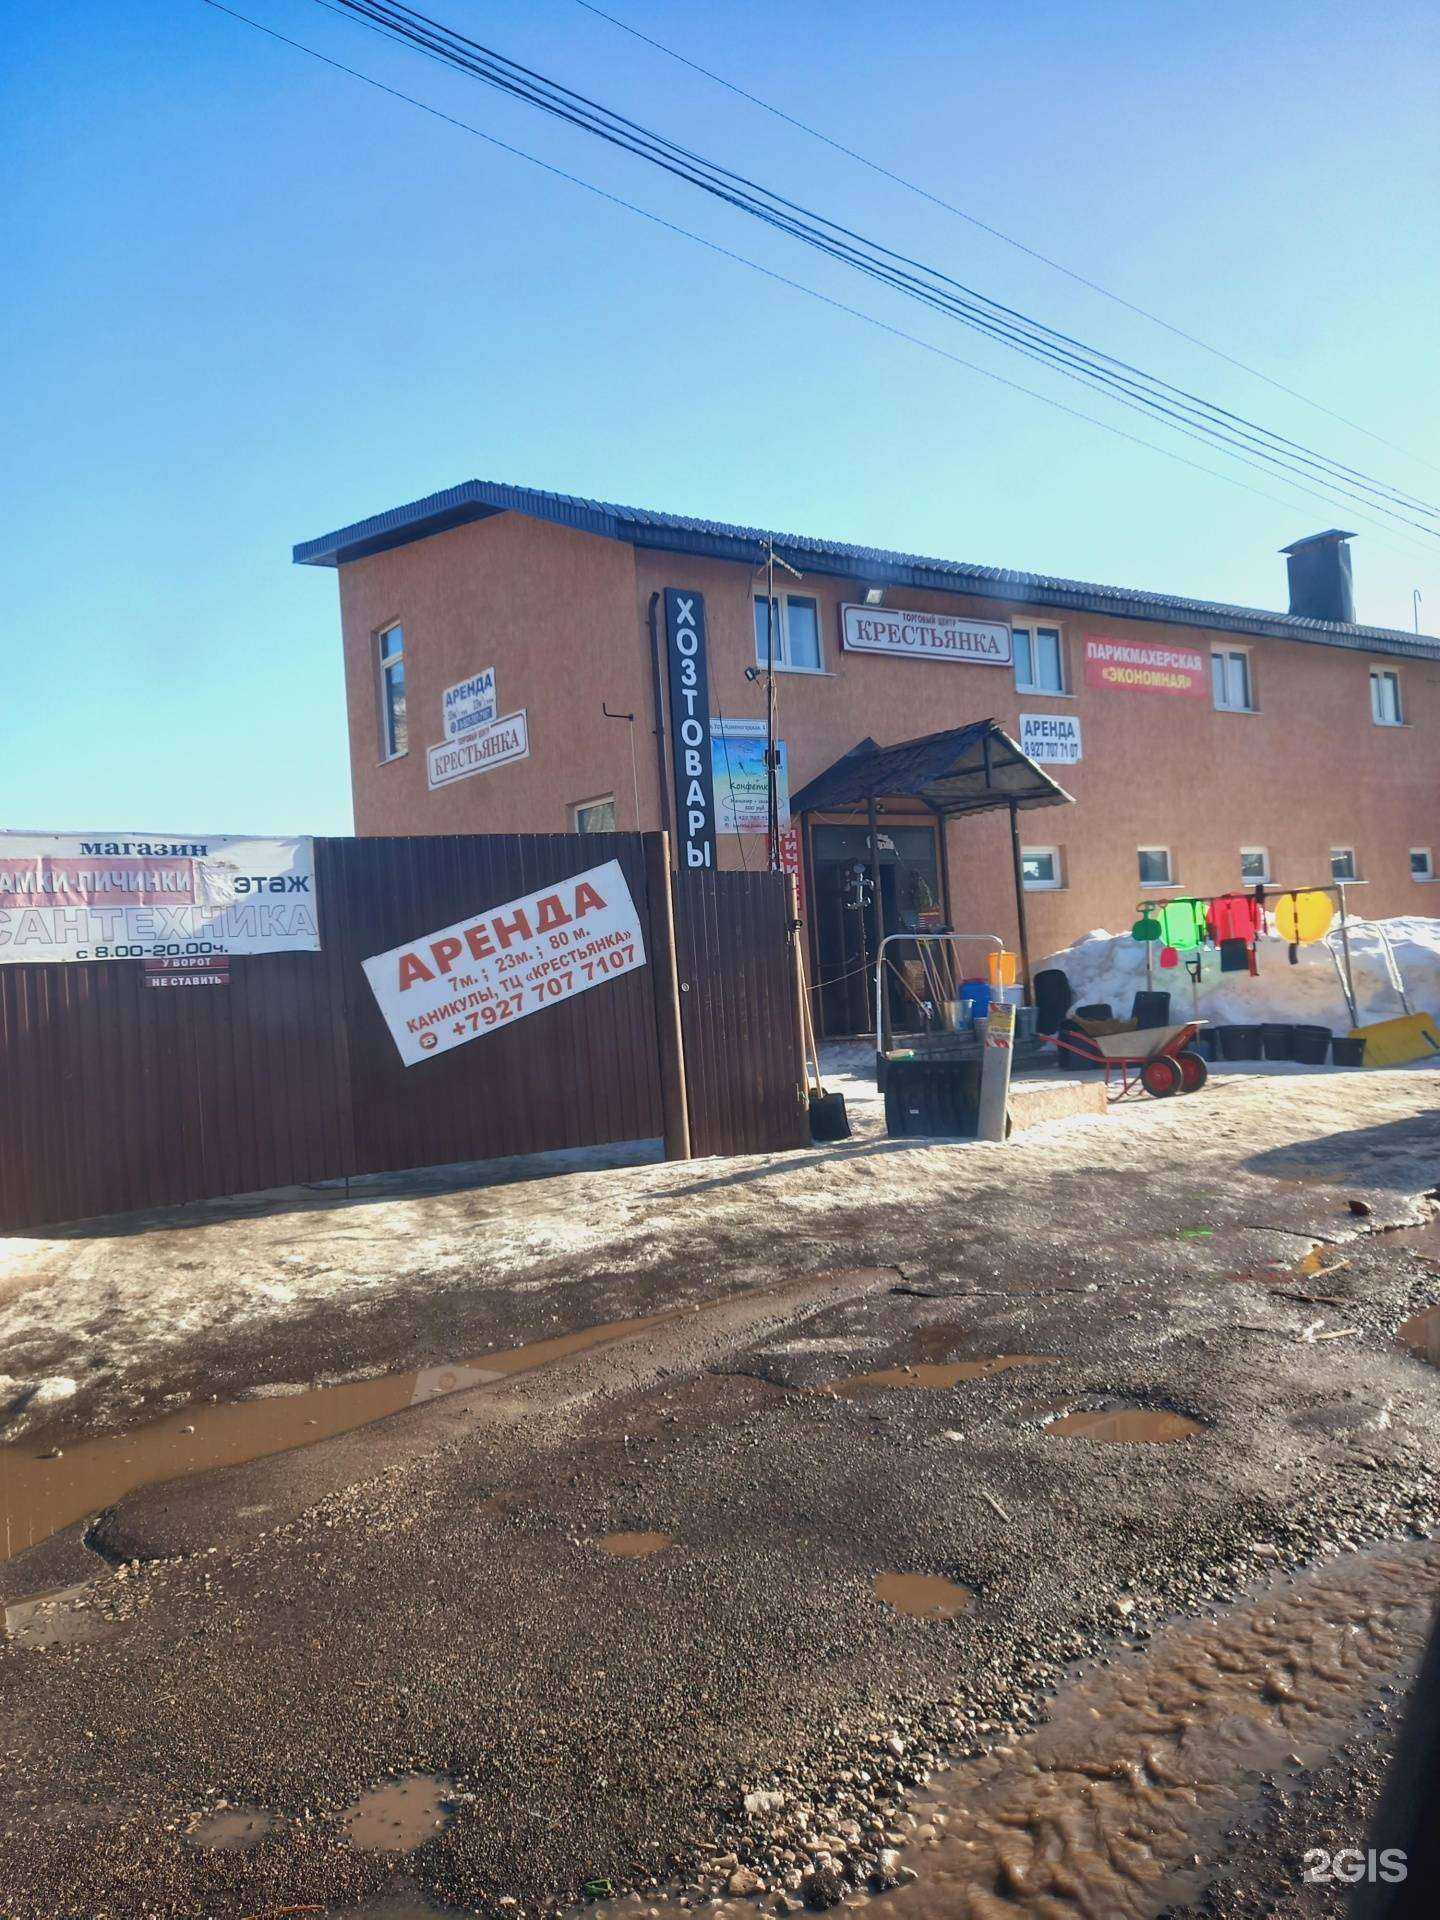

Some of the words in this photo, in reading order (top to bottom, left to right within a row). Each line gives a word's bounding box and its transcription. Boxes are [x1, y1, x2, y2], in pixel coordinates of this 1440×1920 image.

[902, 613, 936, 624] ТОРГОВЫЙ
[856, 619, 1001, 654] КРЕСТЬЯНКА
[1087, 642, 1202, 671] ПАРИКМАХЕРСКАЯ
[446, 673, 493, 708] АРЕНДА
[676, 597, 711, 868] ХОЗТОВАРЫ
[1025, 720, 1075, 740] АРЕНДА
[434, 729, 520, 776] КРЕСТЬЯНКА
[729, 781, 768, 793] Конфетк
[80, 842, 208, 857] магазин
[234, 875, 310, 894] этаж
[398, 882, 608, 993] АРЕНДА
[76, 950, 88, 960] с
[173, 957, 212, 968] ВОРОТ
[152, 978, 168, 987] НЕ
[171, 976, 222, 987] СТАВИТЬ
[406, 987, 499, 1034] КАНИКУЛЫ,
[499, 974, 524, 993] ТЦ
[525, 930, 632, 982] «КРЕСТЬЯНКА»
[452, 992, 524, 1037] +7927
[531, 971, 574, 1002] 707
[580, 944, 635, 981] 7107
